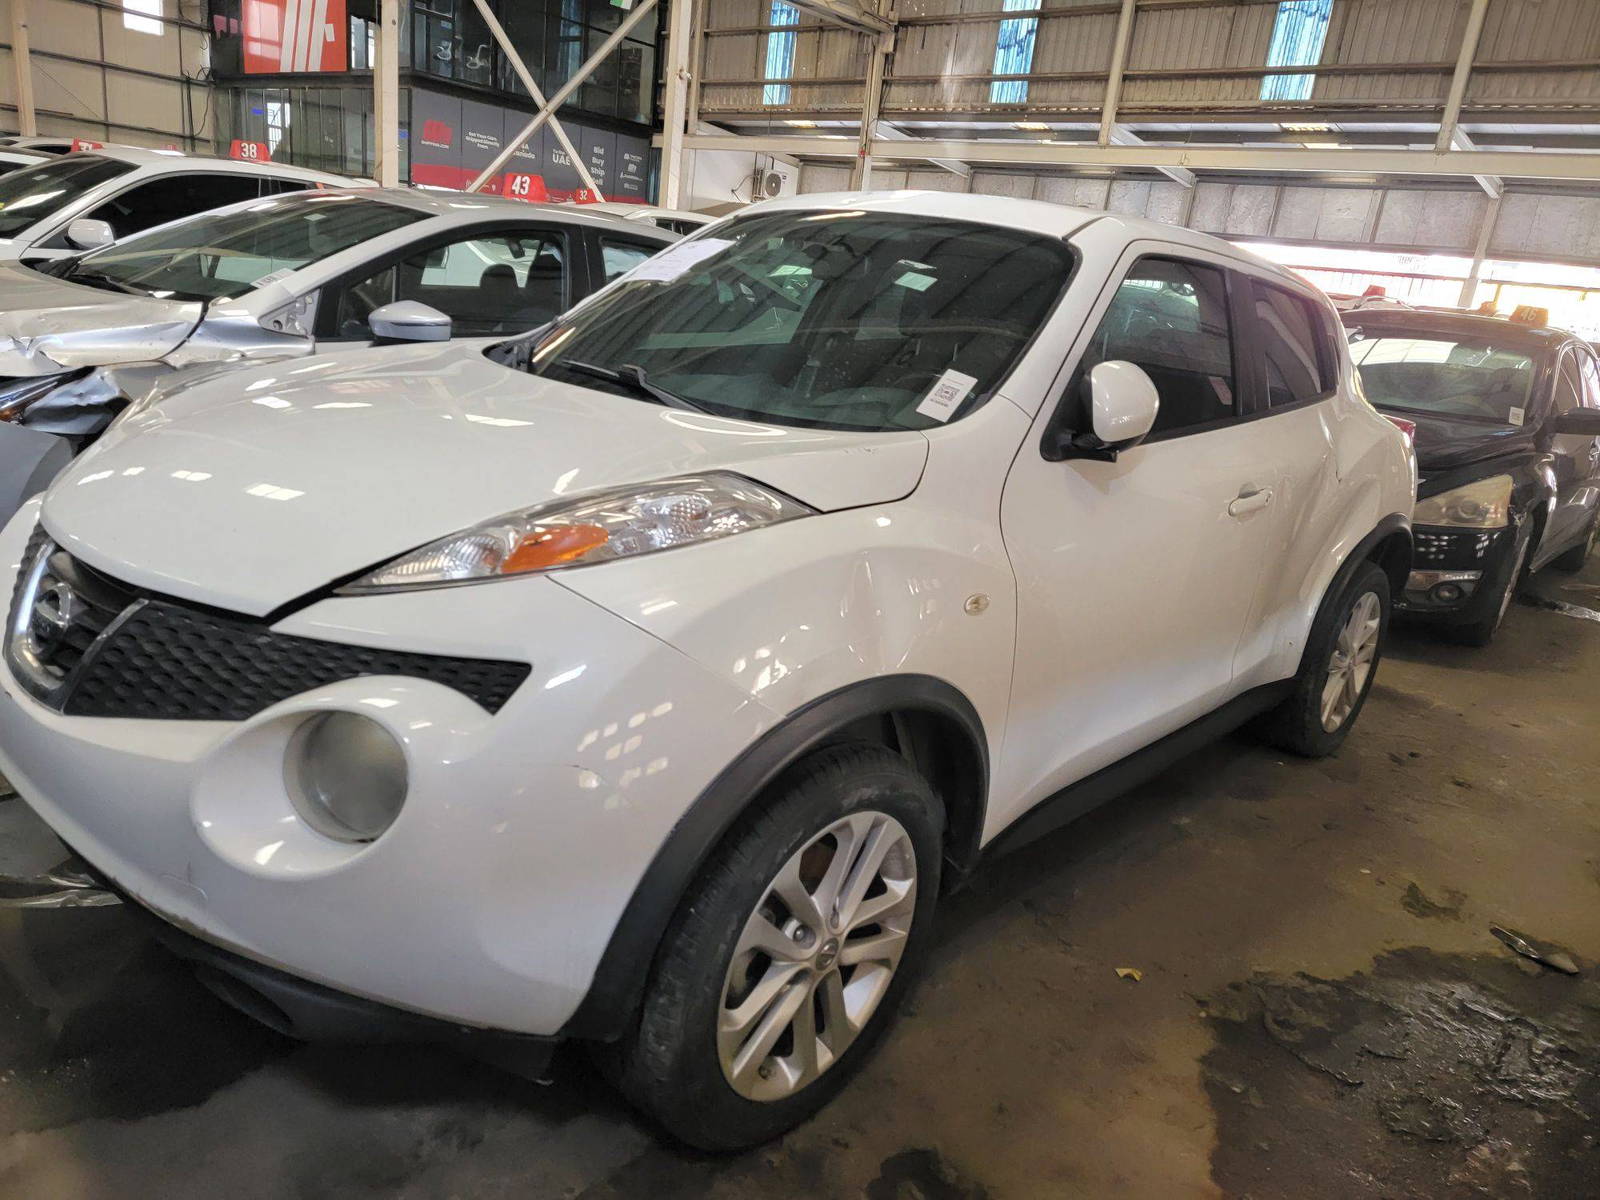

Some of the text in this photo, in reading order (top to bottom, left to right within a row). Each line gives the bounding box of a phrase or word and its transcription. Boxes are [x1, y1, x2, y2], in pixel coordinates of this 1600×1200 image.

[241, 142, 257, 159] 38
[511, 175, 531, 196] 43
[579, 189, 588, 200] 32
